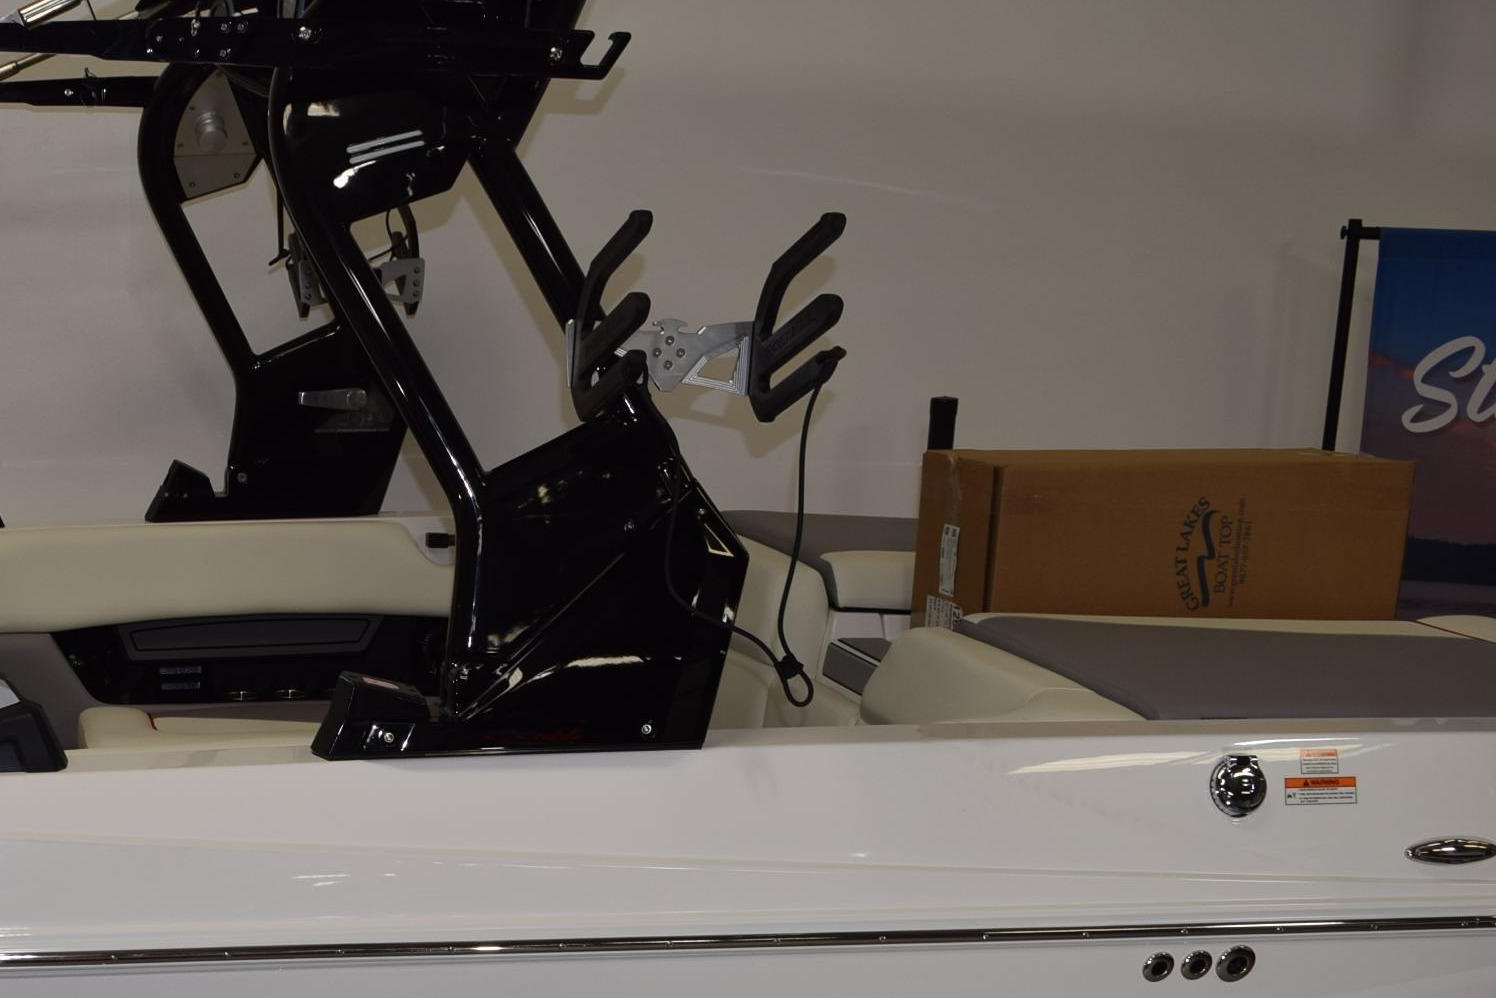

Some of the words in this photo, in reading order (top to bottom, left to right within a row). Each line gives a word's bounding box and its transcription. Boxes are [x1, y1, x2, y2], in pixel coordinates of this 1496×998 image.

[1175, 496, 1211, 553] LAKES
[1219, 515, 1233, 546] TOP
[1175, 556, 1201, 612] GREAT
[1214, 554, 1230, 593] BOAT
